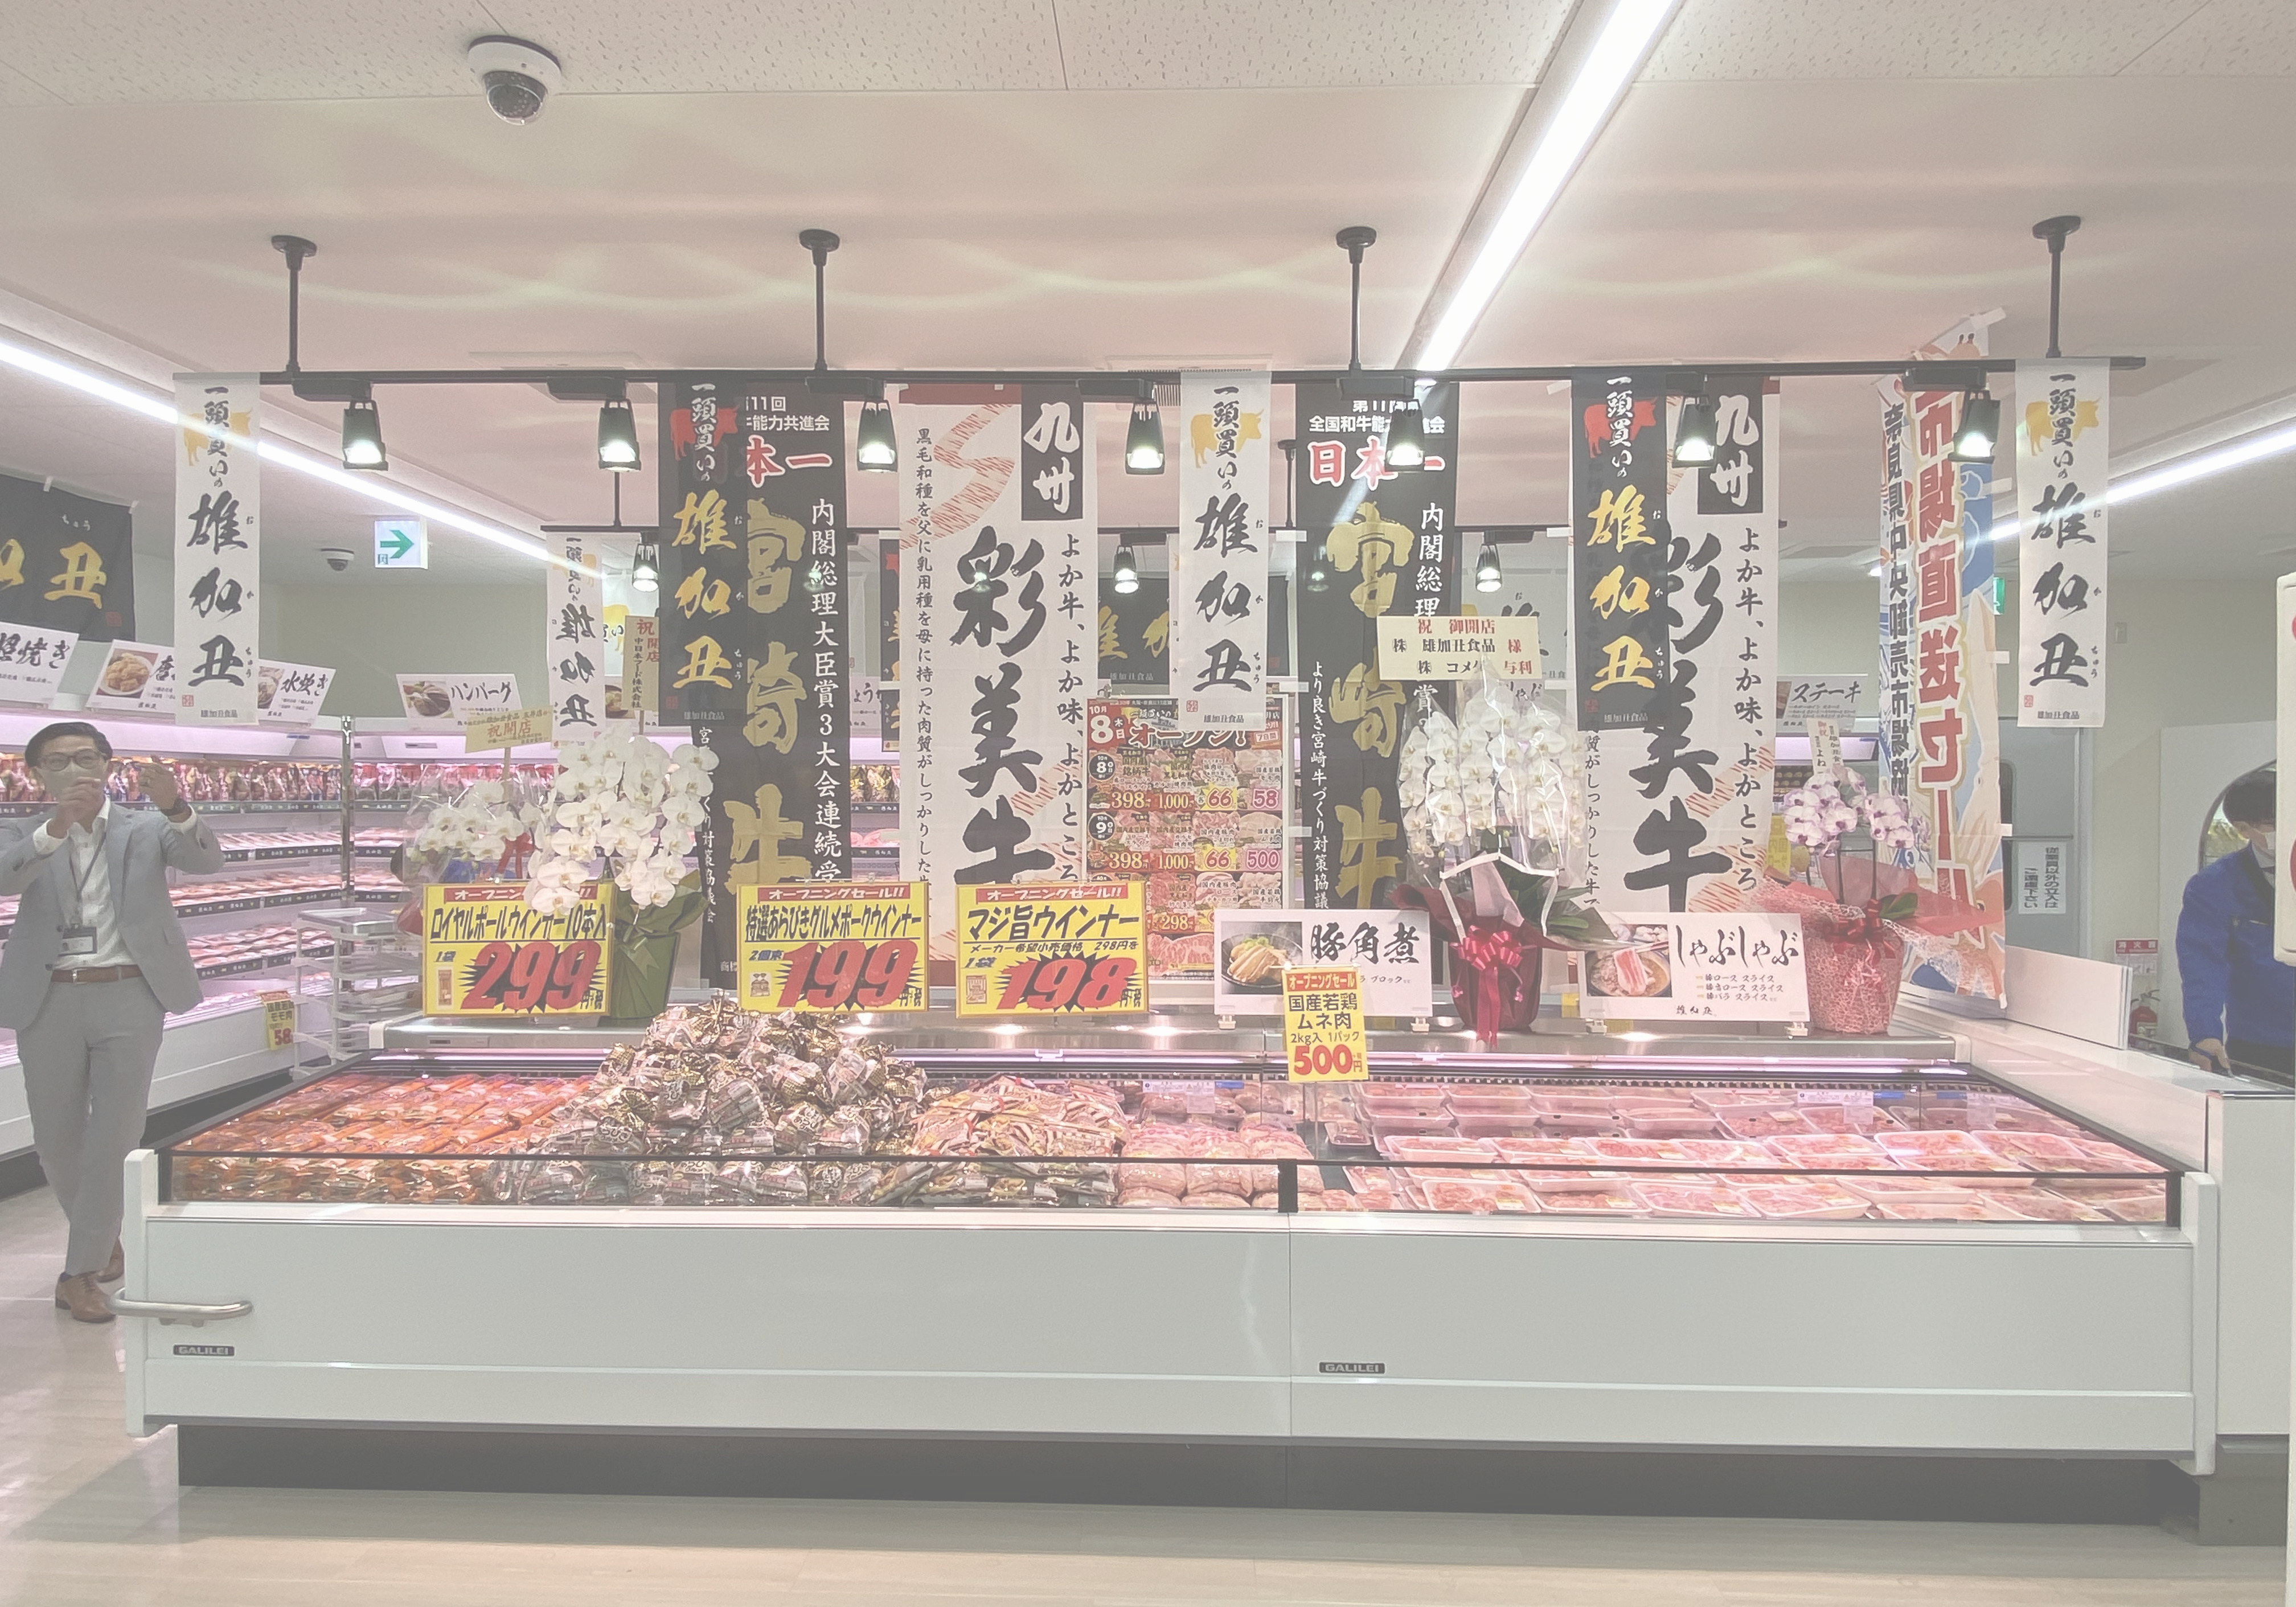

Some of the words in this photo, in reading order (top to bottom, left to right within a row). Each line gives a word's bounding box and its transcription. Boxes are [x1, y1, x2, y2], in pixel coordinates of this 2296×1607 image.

[691, 383, 716, 481] 一頭買いの
[747, 415, 830, 431] 能力共進会
[1213, 386, 1240, 490] 一頭買いの
[1606, 376, 1633, 477] 一頭買いの
[2049, 373, 2076, 479] 一頭買いの
[1023, 402, 1081, 513] 九州
[1709, 395, 1760, 507] 九州
[187, 490, 248, 687] 雄加丑
[671, 489, 737, 689] 雄加丑
[1193, 493, 1257, 692] 雄加丑
[1586, 485, 1656, 691] 雄加丑
[2030, 482, 2096, 687] 雄加丑
[1418, 618, 1433, 634] 祝
[1449, 619, 1495, 634] 御開店
[1422, 638, 1496, 653] 雄加丑食品
[1507, 639, 1522, 654] 様
[450, 681, 512, 703] ハンバーグ
[949, 525, 1056, 884] 彩美牛
[1791, 680, 1862, 703] ステーキ
[1090, 715, 1114, 744] 8
[1112, 792, 1145, 809] 398
[1207, 788, 1233, 809] 66
[1253, 788, 1280, 809] 58
[1109, 852, 1142, 869] 398
[1205, 849, 1232, 870] 66
[1247, 849, 1281, 870] 500
[967, 903, 1139, 940] マジ旨ウインナー
[1161, 914, 1188, 930] 298
[1310, 921, 1420, 965] 豚角煮
[1676, 925, 1799, 969] しゃぶしゃぶ
[460, 941, 602, 1010] 299
[777, 939, 919, 1010] 199
[996, 957, 1137, 1010] 198
[1288, 993, 1358, 1012] 国産若鶏
[1297, 1012, 1352, 1030] ムネ肉
[1290, 1032, 1323, 1046] 2kg入
[1293, 1044, 1353, 1076] 500
[178, 1346, 229, 1355] GALILEI
[1325, 1364, 1379, 1373] GALILEI
